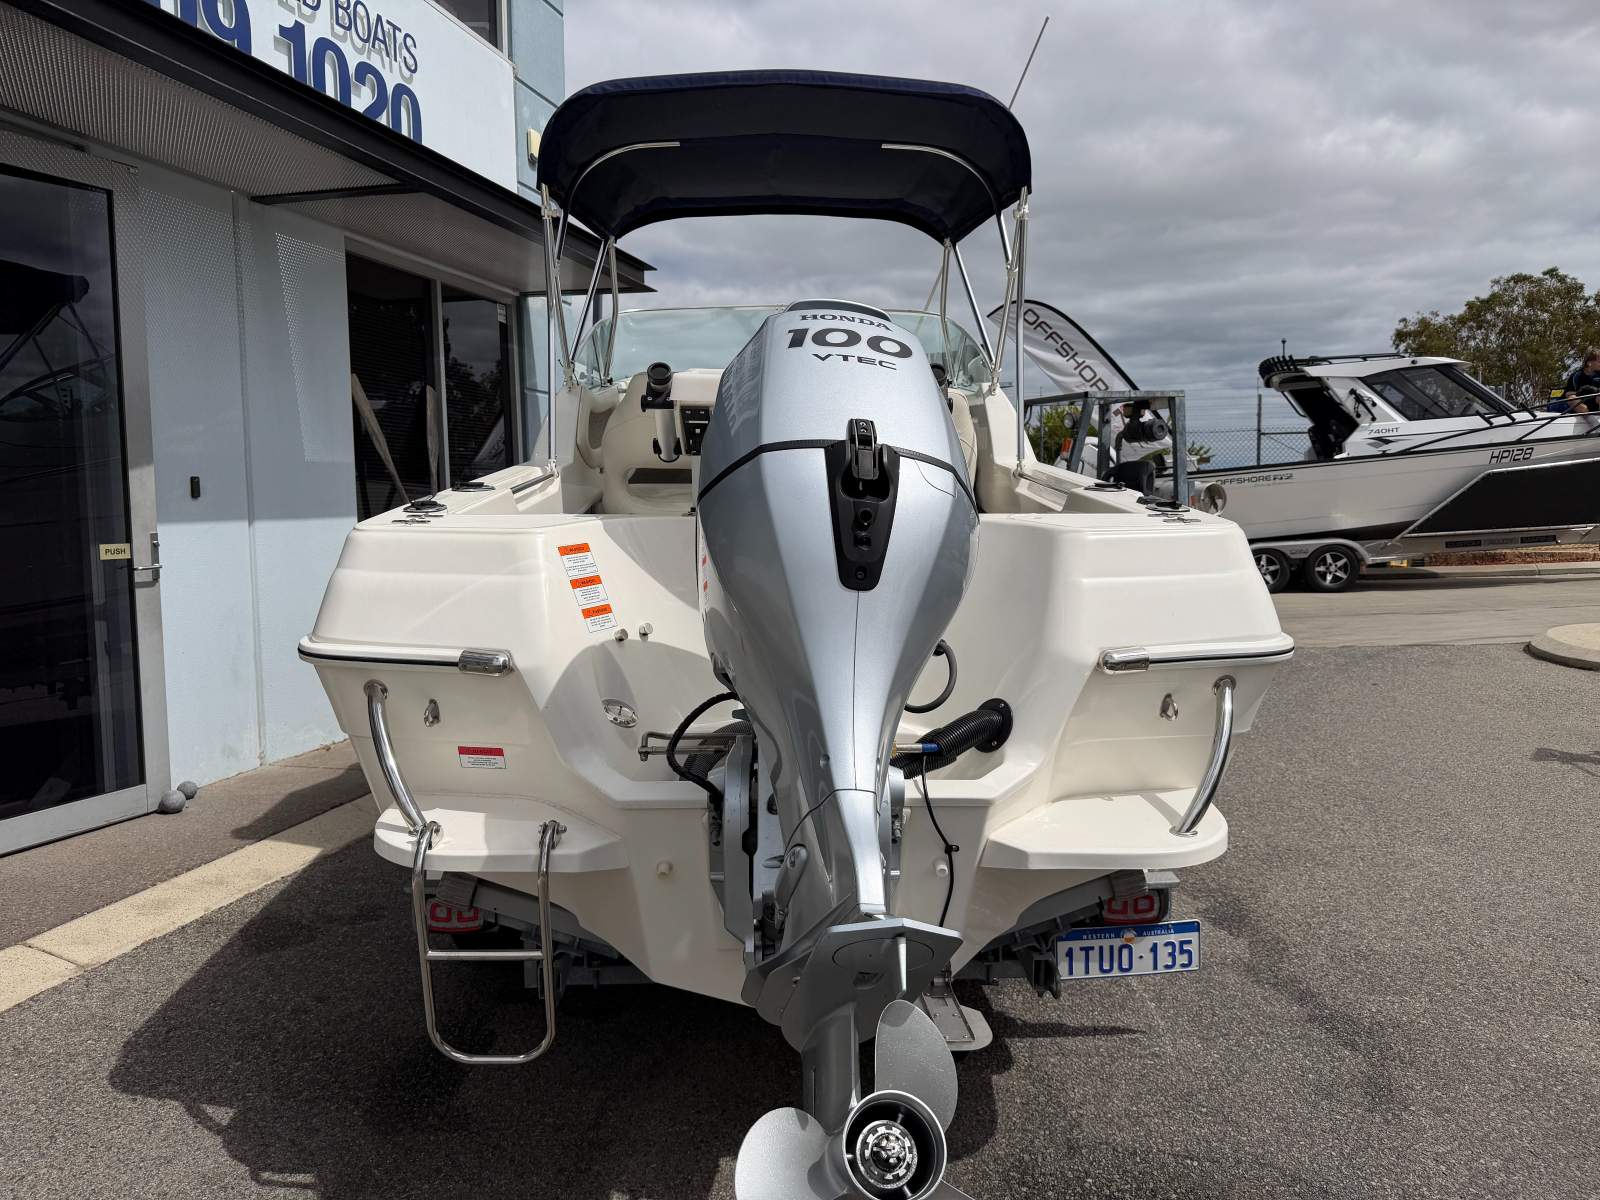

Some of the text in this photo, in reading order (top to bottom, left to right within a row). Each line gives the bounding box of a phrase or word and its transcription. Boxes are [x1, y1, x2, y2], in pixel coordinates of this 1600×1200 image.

[335, 0, 418, 73] BOATS
[278, 19, 422, 145] 1020
[800, 314, 893, 332] HONDA
[787, 327, 913, 359] 100
[812, 353, 897, 371] VTEC
[1489, 447, 1534, 464] HP128
[1216, 475, 1272, 485] OFFSHORE
[1143, 928, 1175, 937] AUSTRALIA
